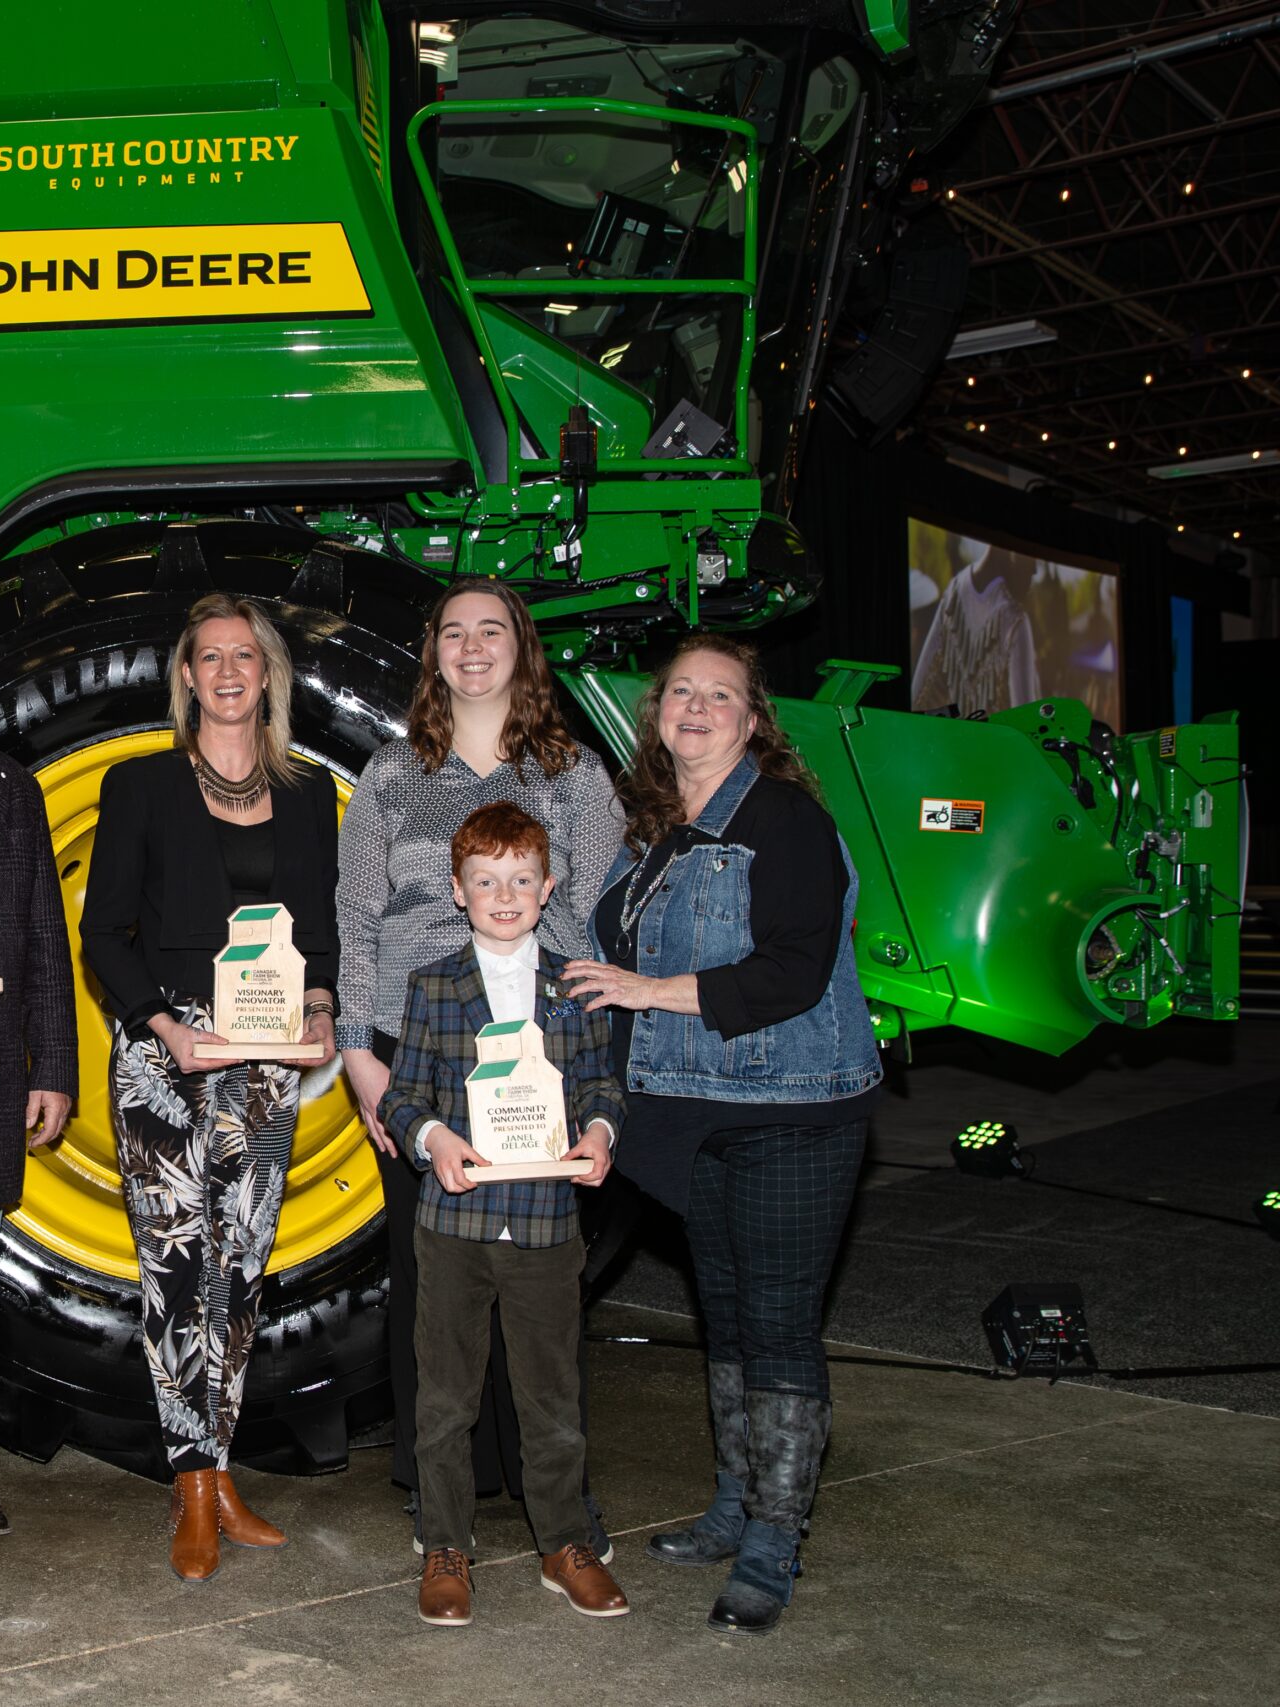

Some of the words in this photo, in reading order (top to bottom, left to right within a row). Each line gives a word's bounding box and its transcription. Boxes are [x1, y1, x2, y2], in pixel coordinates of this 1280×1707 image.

[123, 135, 299, 168] COUNTRY
[49, 171, 245, 191] EQUIPMENT
[117, 249, 312, 291] DEERE
[234, 997, 286, 1005] INNOVATOR
[237, 1015, 282, 1023] CHERILYN
[229, 1022, 258, 1030] JOLLY
[259, 1022, 289, 1030] NAGEL
[487, 1104, 548, 1116] COMMUNITY
[490, 1113, 546, 1124] INNOVATOR
[493, 1124, 535, 1132] PRESENTED
[505, 1133, 535, 1142] JANEL
[501, 1141, 540, 1150] DELAGE
